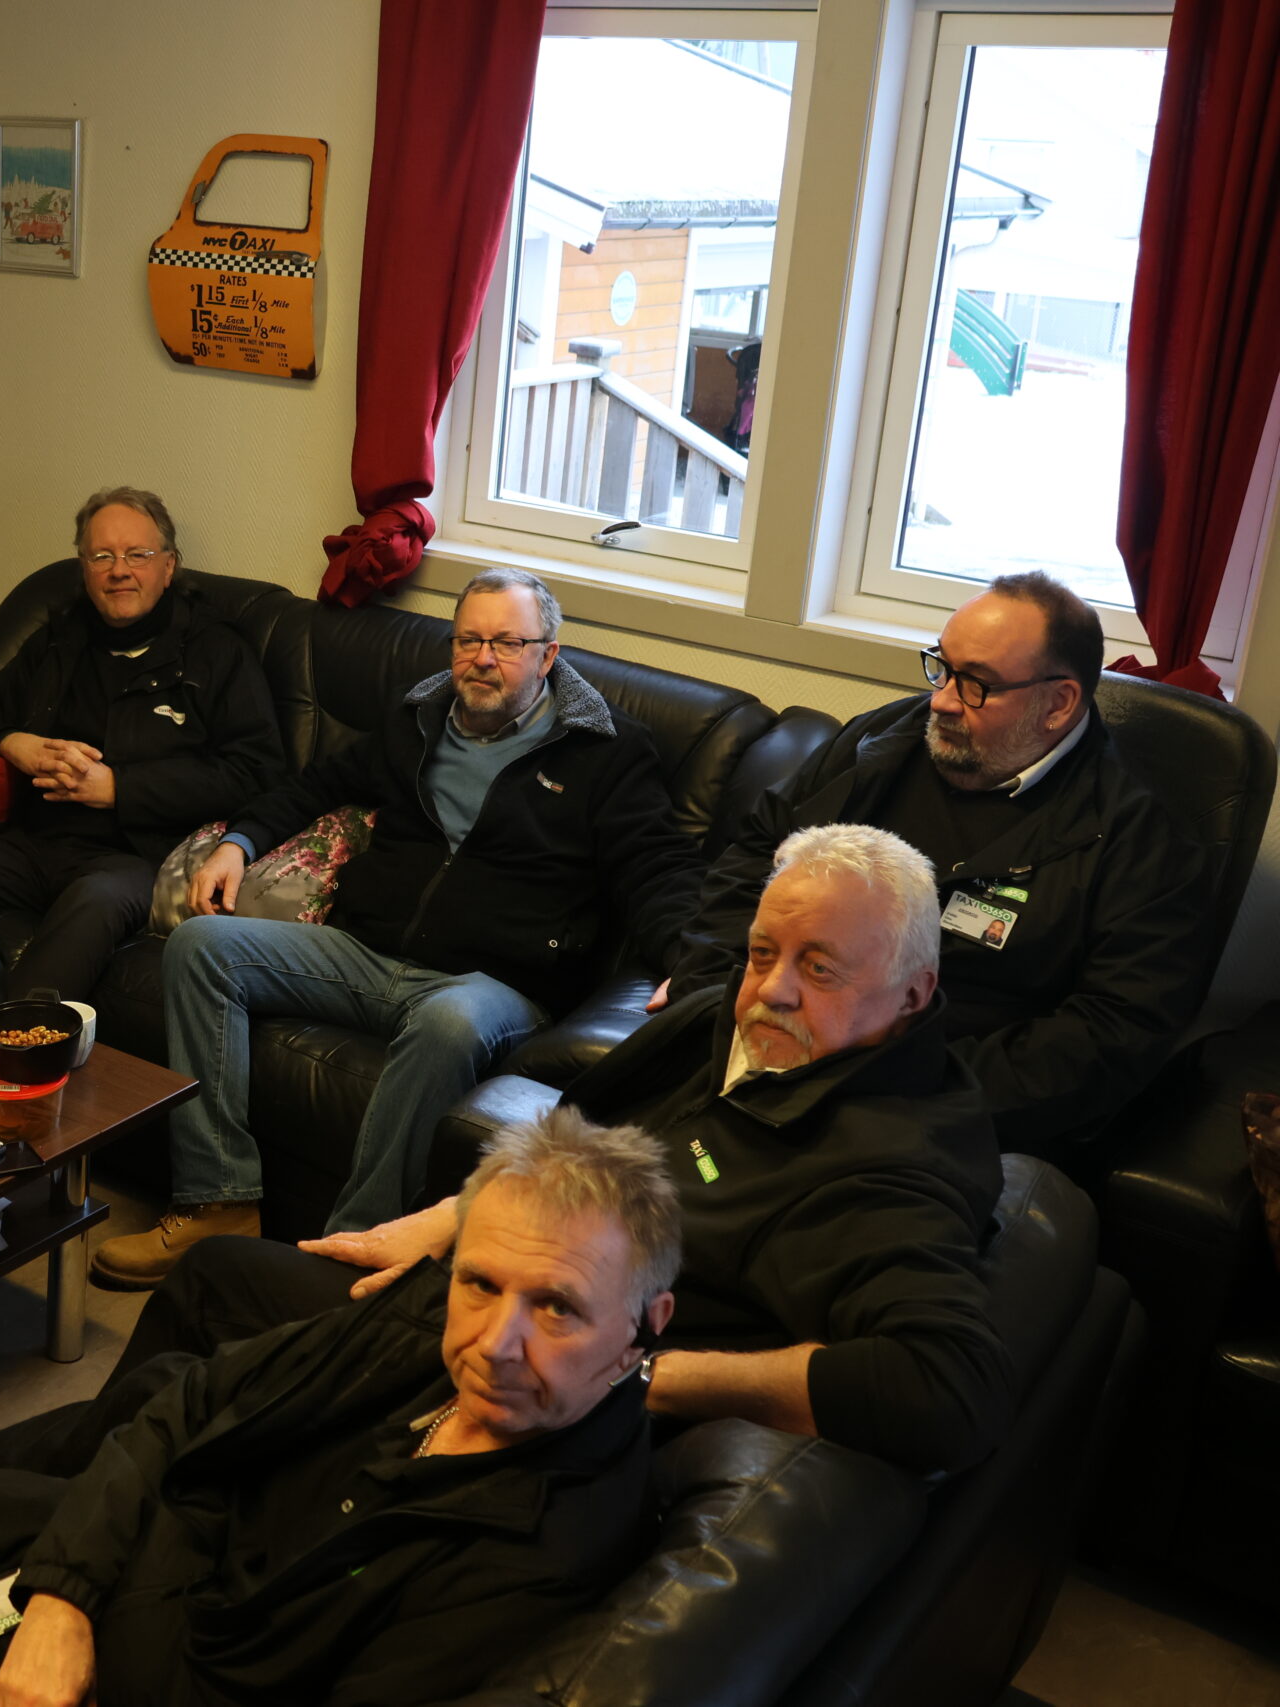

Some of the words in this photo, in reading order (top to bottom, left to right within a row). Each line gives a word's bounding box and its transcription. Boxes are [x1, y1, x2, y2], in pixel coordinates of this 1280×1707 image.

[202, 236, 227, 248] NYC
[229, 231, 276, 251] TAXI
[219, 274, 247, 286] RATES
[230, 295, 250, 306] First
[251, 289, 269, 313] 1/8
[271, 299, 290, 309] Mile
[214, 321, 253, 334] Additional
[225, 315, 246, 325] Each
[253, 315, 270, 340] 1/8
[269, 325, 287, 334] Mile
[955, 893, 978, 909] TAXI
[981, 903, 1011, 920] 03650
